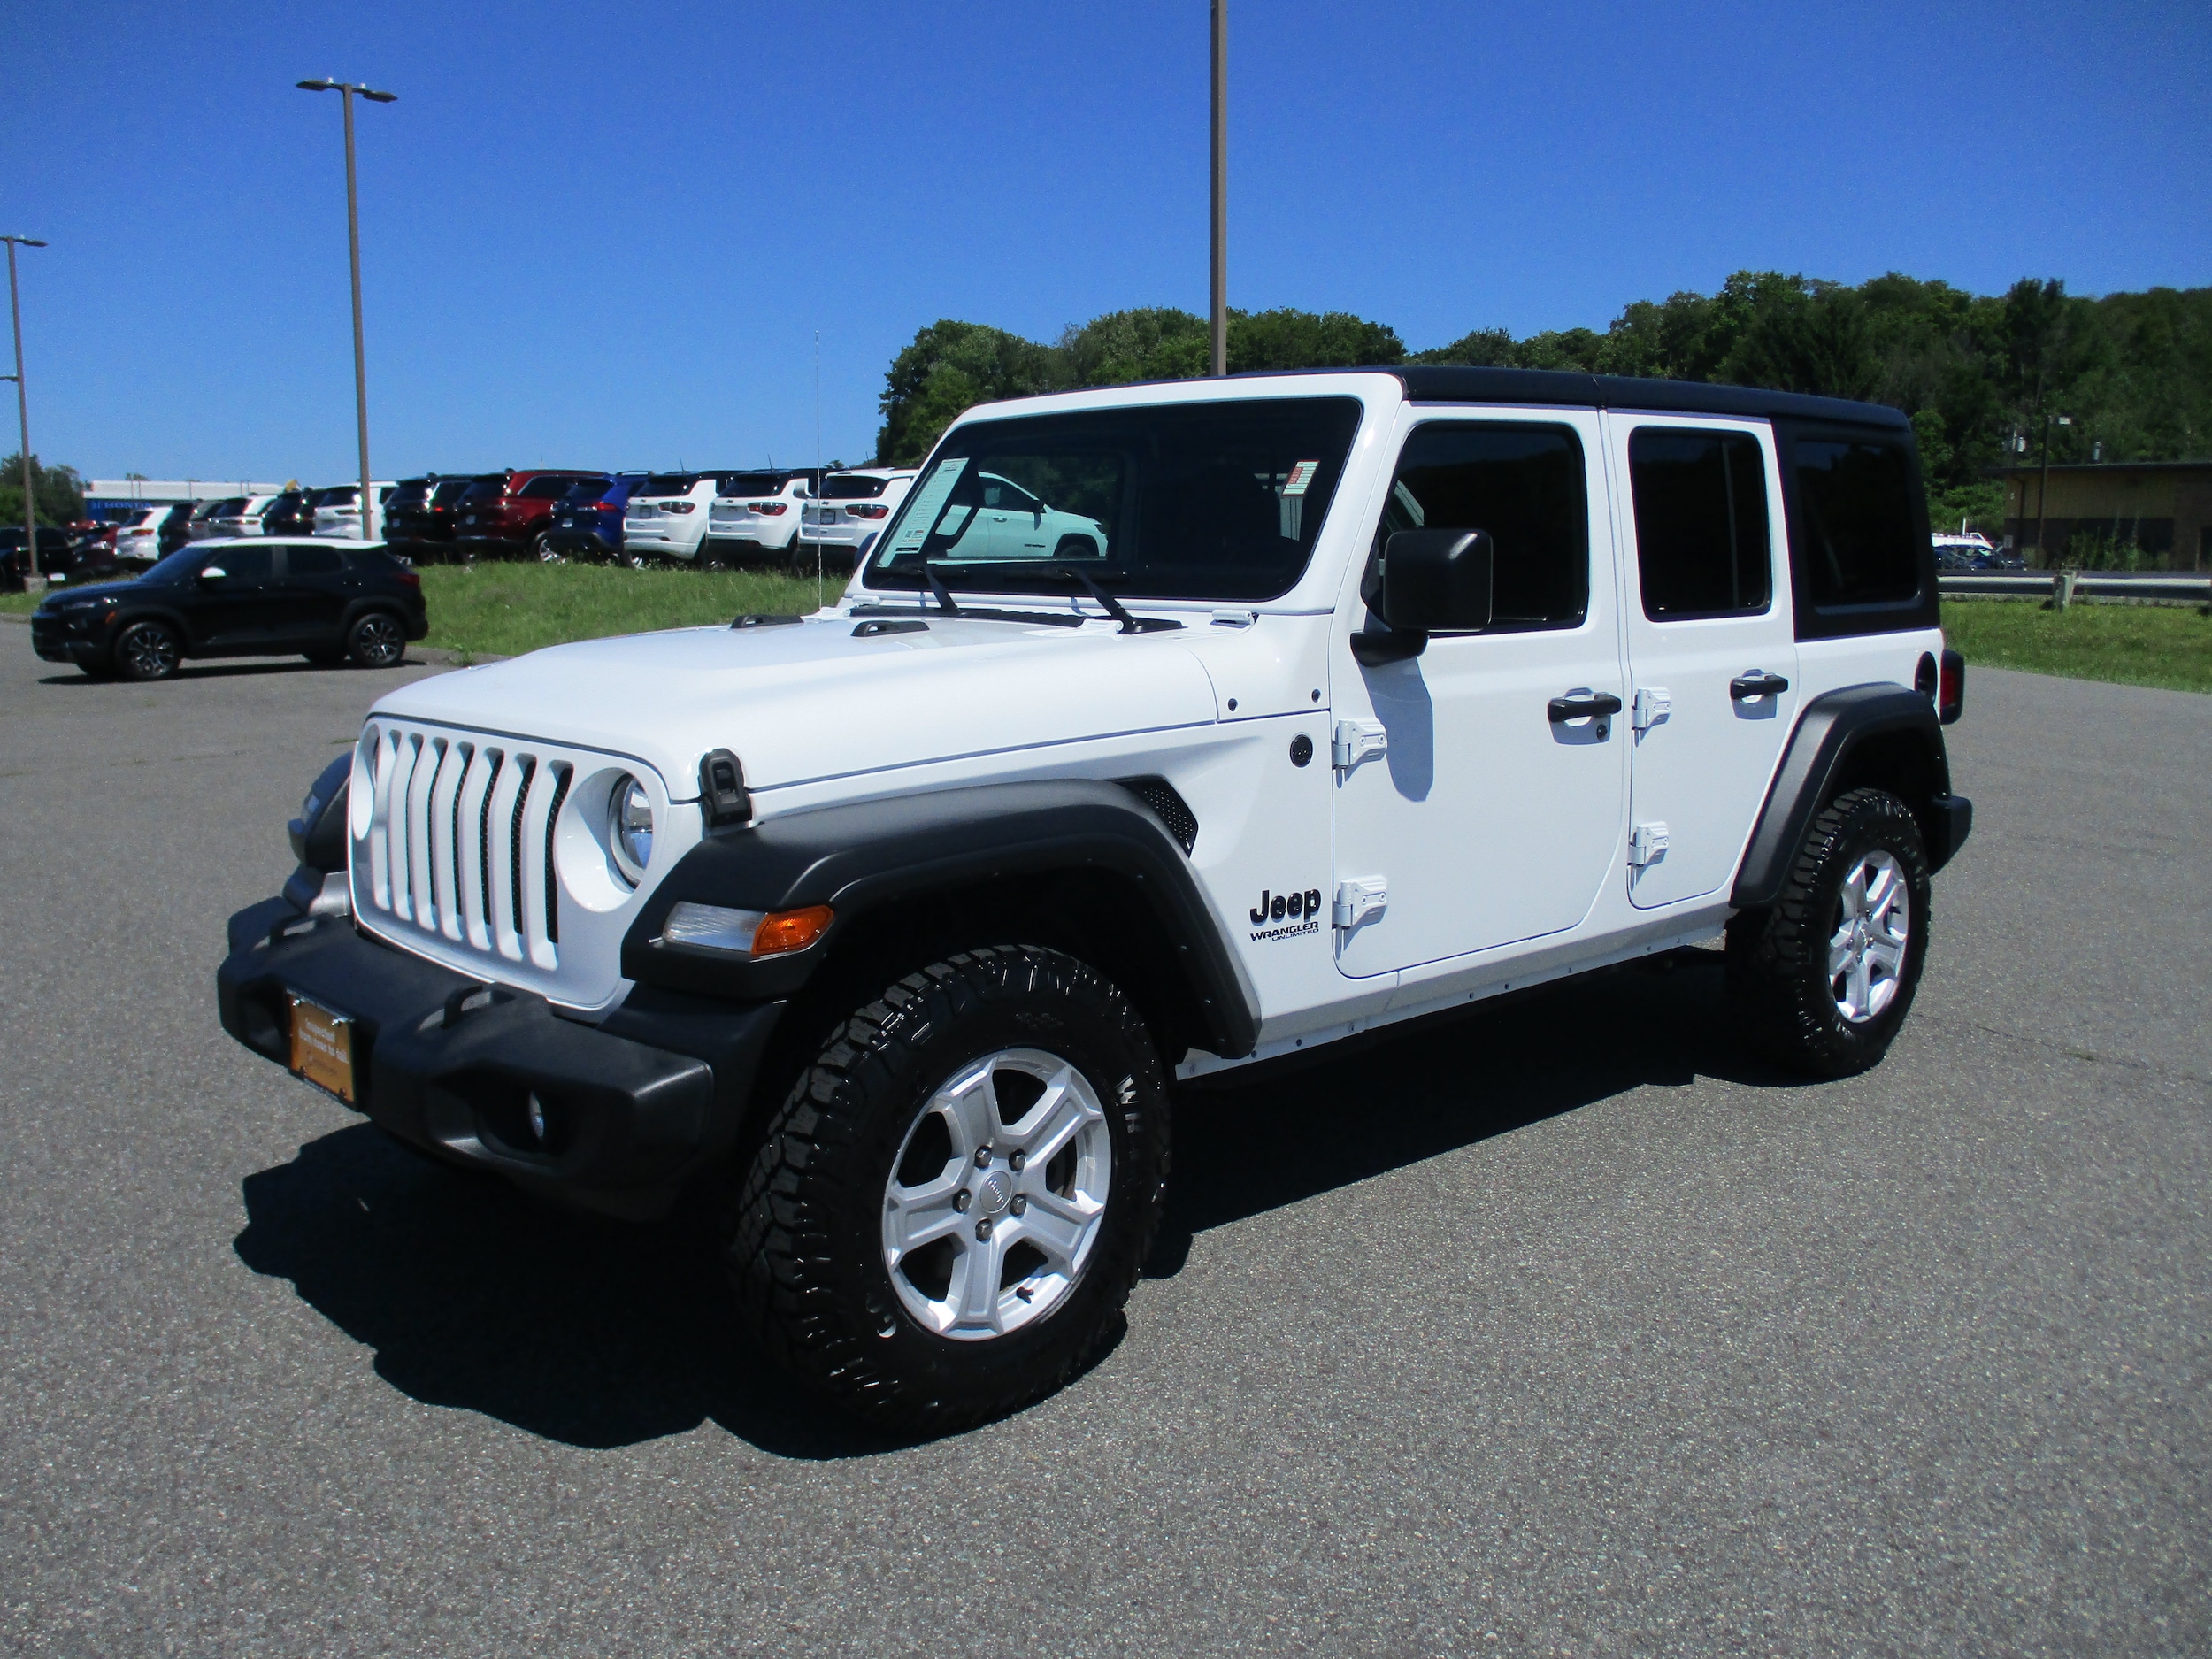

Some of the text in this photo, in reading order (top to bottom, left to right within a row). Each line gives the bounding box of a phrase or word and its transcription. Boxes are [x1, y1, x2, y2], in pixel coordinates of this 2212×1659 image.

[1249, 888, 1321, 924] Jeep
[1249, 921, 1319, 941] WRANGLER
[1271, 928, 1319, 941] UNLIMITED
